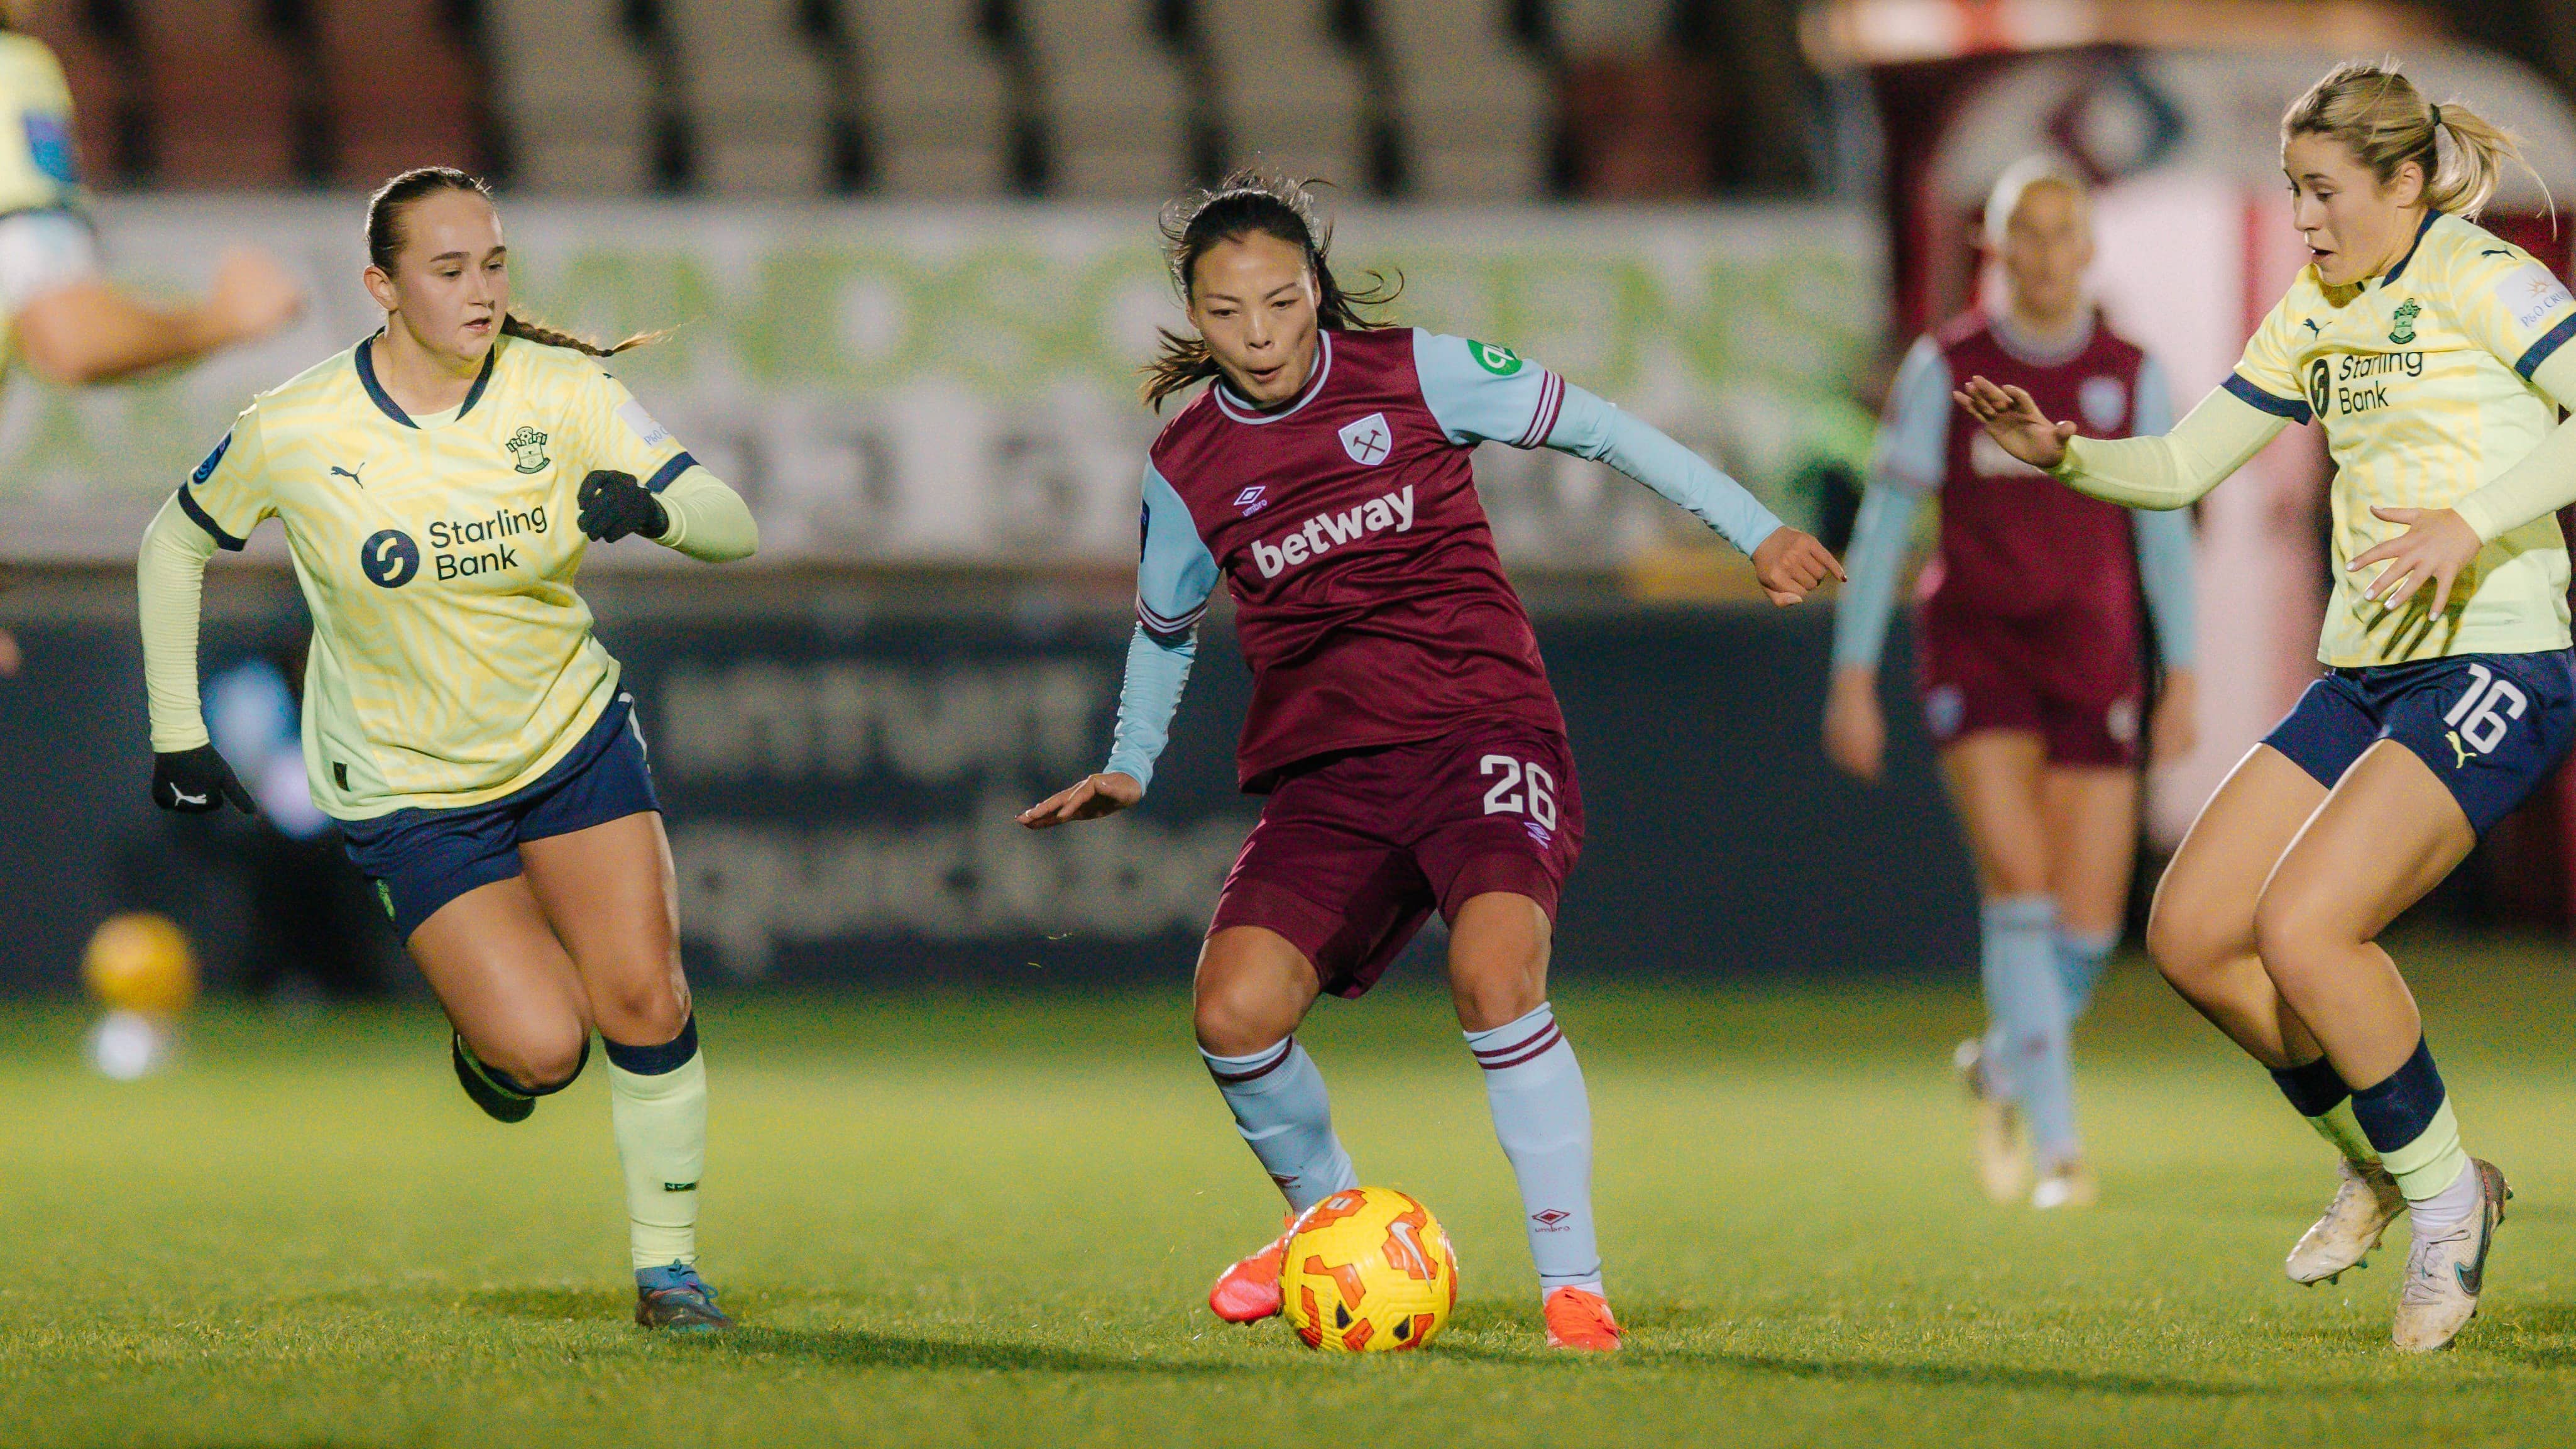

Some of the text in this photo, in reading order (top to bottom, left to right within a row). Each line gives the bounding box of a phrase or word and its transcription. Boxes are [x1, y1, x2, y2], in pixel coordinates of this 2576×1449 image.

[2339, 351, 2423, 382] Starling
[2338, 380, 2389, 415] Bank
[429, 505, 547, 549] Starling
[1242, 499, 1268, 517] umbro
[1251, 483, 1414, 579] betway
[435, 543, 519, 581] Bank
[2442, 663, 2528, 754] 16
[1479, 754, 1557, 831] 26
